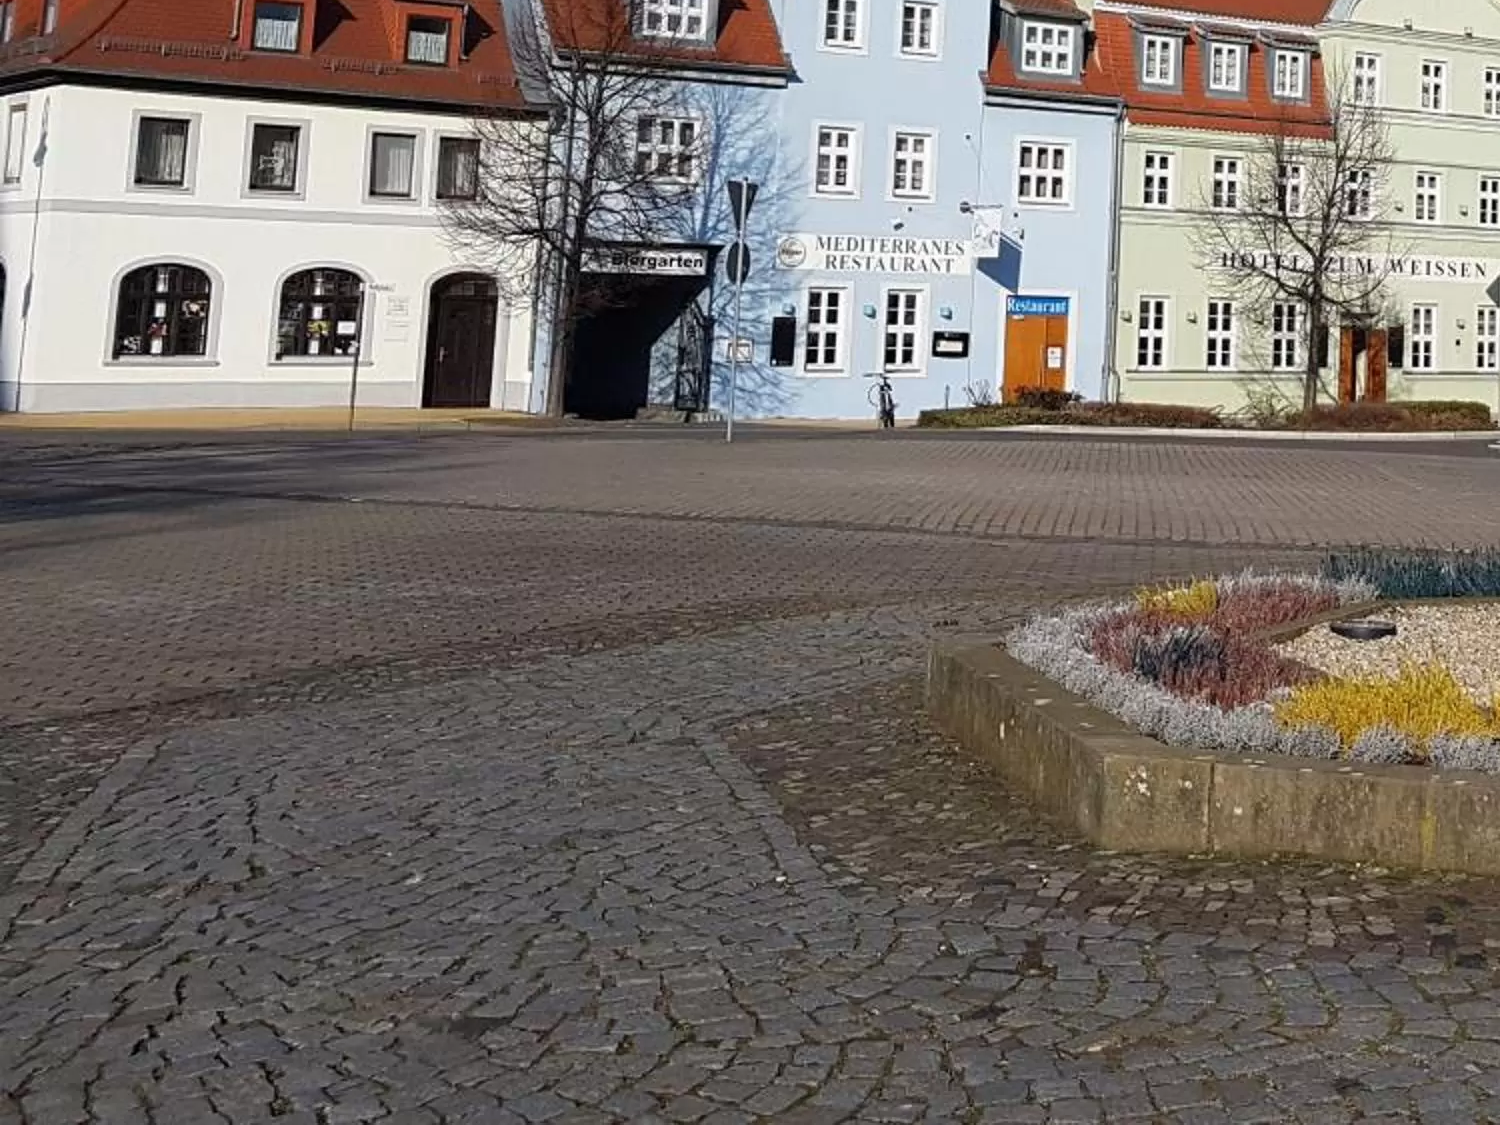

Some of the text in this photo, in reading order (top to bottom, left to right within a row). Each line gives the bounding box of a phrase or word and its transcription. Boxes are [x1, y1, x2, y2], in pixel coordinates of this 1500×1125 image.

[815, 235, 966, 256] MEDITERRANES
[611, 252, 704, 270] Biergarten
[825, 254, 956, 274] RESTAURANT
[1389, 257, 1487, 277] WEISSEN
[1007, 298, 1067, 313] Restaurant
